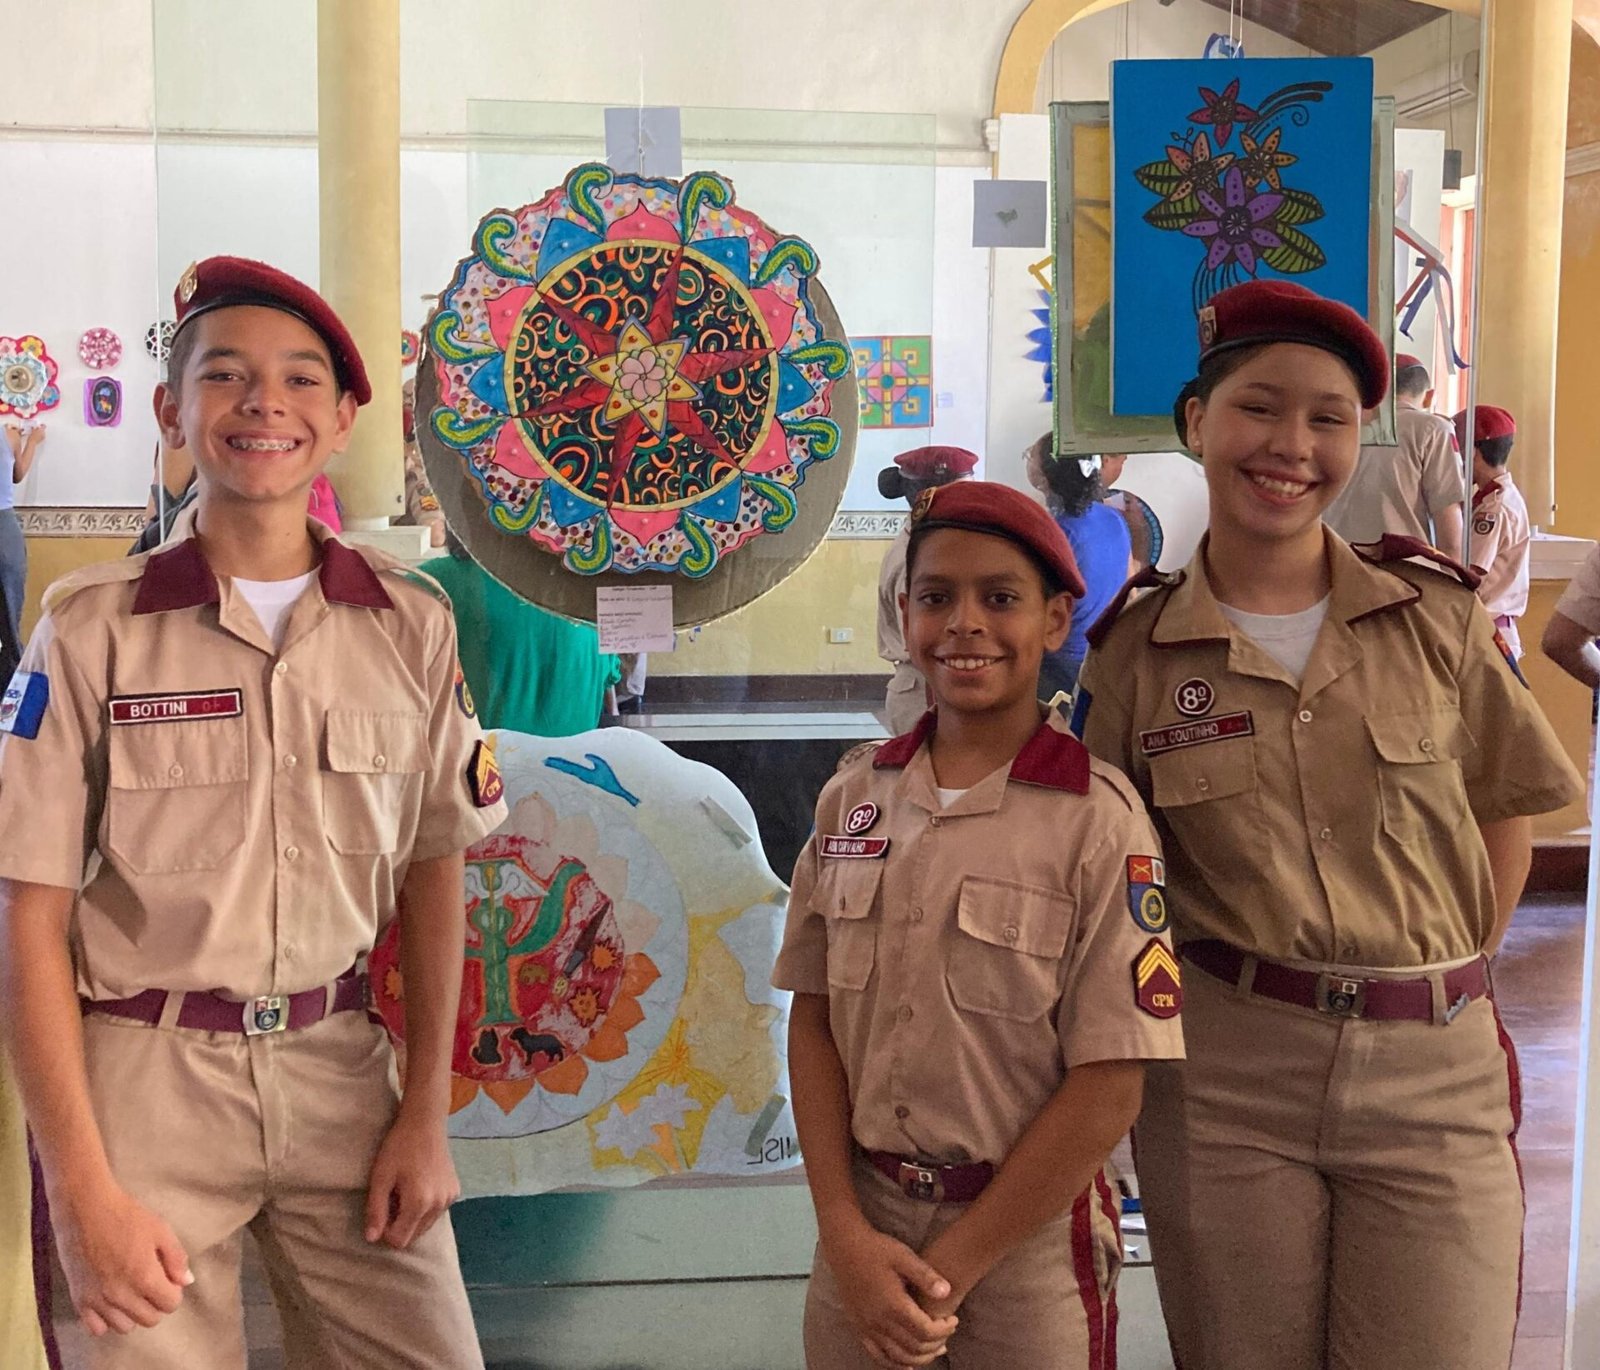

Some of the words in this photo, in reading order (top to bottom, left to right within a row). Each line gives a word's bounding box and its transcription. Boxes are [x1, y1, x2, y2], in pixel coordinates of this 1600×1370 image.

[129, 701, 187, 717] BOTTINI
[1169, 722, 1219, 743] COUTINHO
[1152, 993, 1175, 1007] CPM
